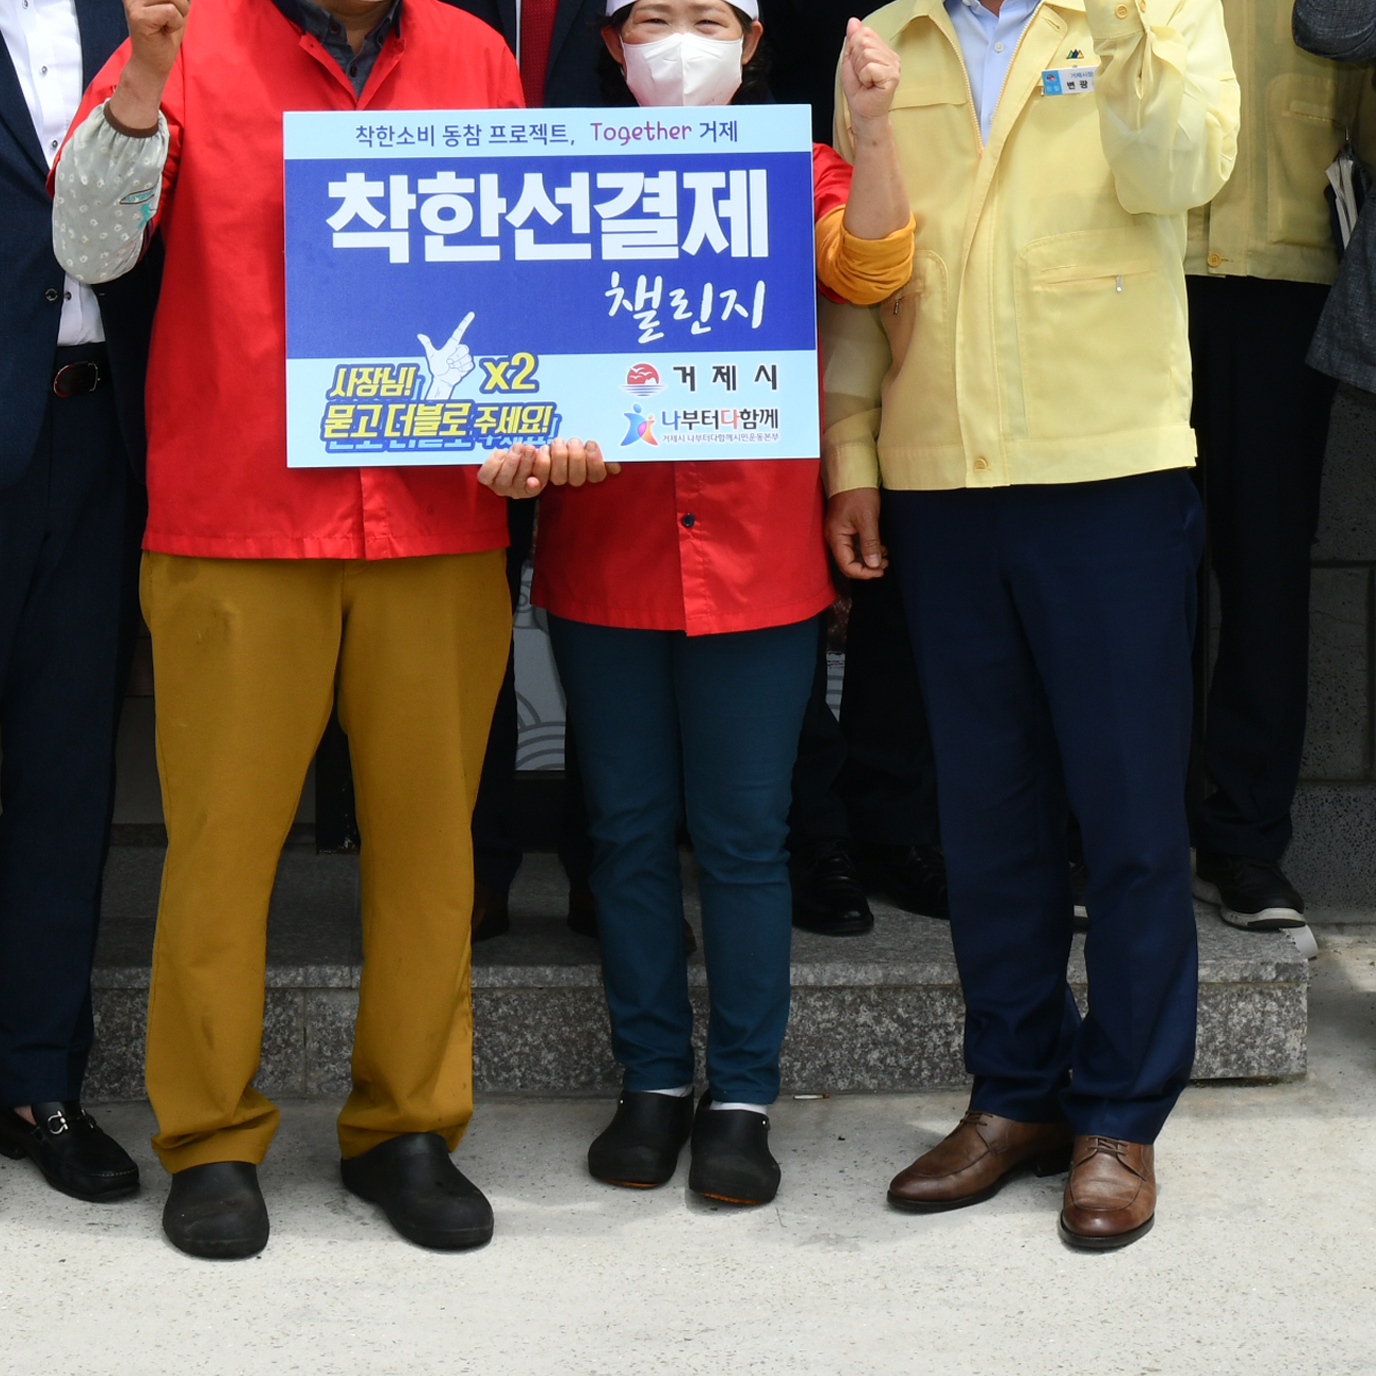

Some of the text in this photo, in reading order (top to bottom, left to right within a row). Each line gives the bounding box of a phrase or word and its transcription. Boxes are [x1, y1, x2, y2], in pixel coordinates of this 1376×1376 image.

[355, 120, 738, 148] 착한소비 동참 프로젝트, Together 거제
[325, 169, 770, 264] 착한선결제
[604, 270, 766, 344] 챌린지
[329, 366, 417, 398] 사장님!
[474, 405, 554, 435] 주세요!
[661, 408, 779, 431] 나부터다함께
[662, 434, 685, 443] 거제시
